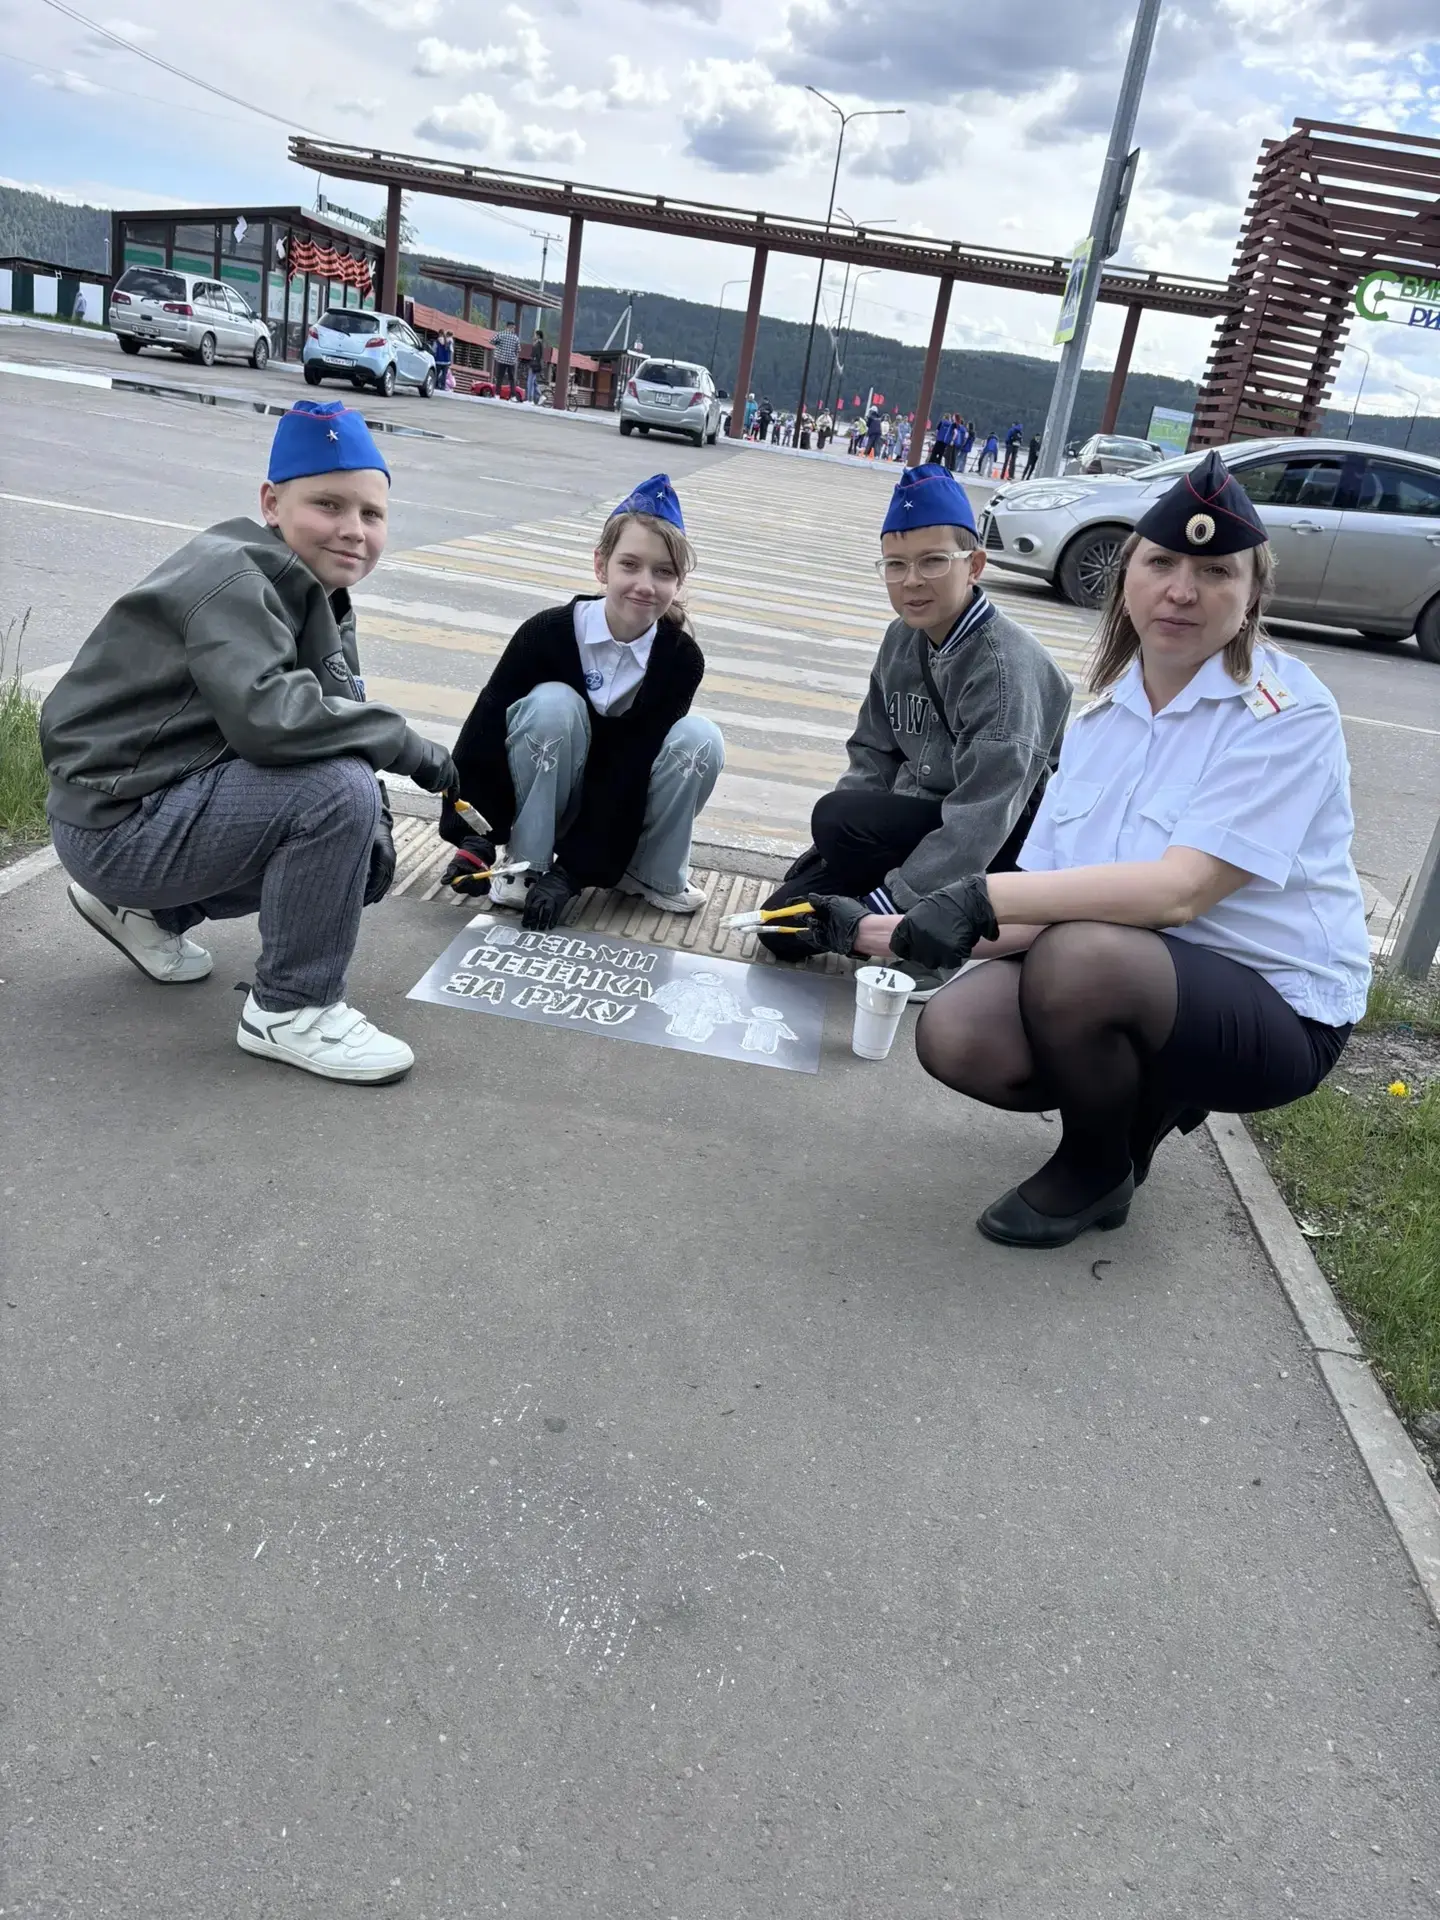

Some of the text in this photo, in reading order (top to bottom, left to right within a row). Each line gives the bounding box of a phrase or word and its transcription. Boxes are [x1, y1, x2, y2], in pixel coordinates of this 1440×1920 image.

[445, 974, 636, 1023] ЗА РУКУ
[463, 947, 653, 1000] РЕБЁНКА
